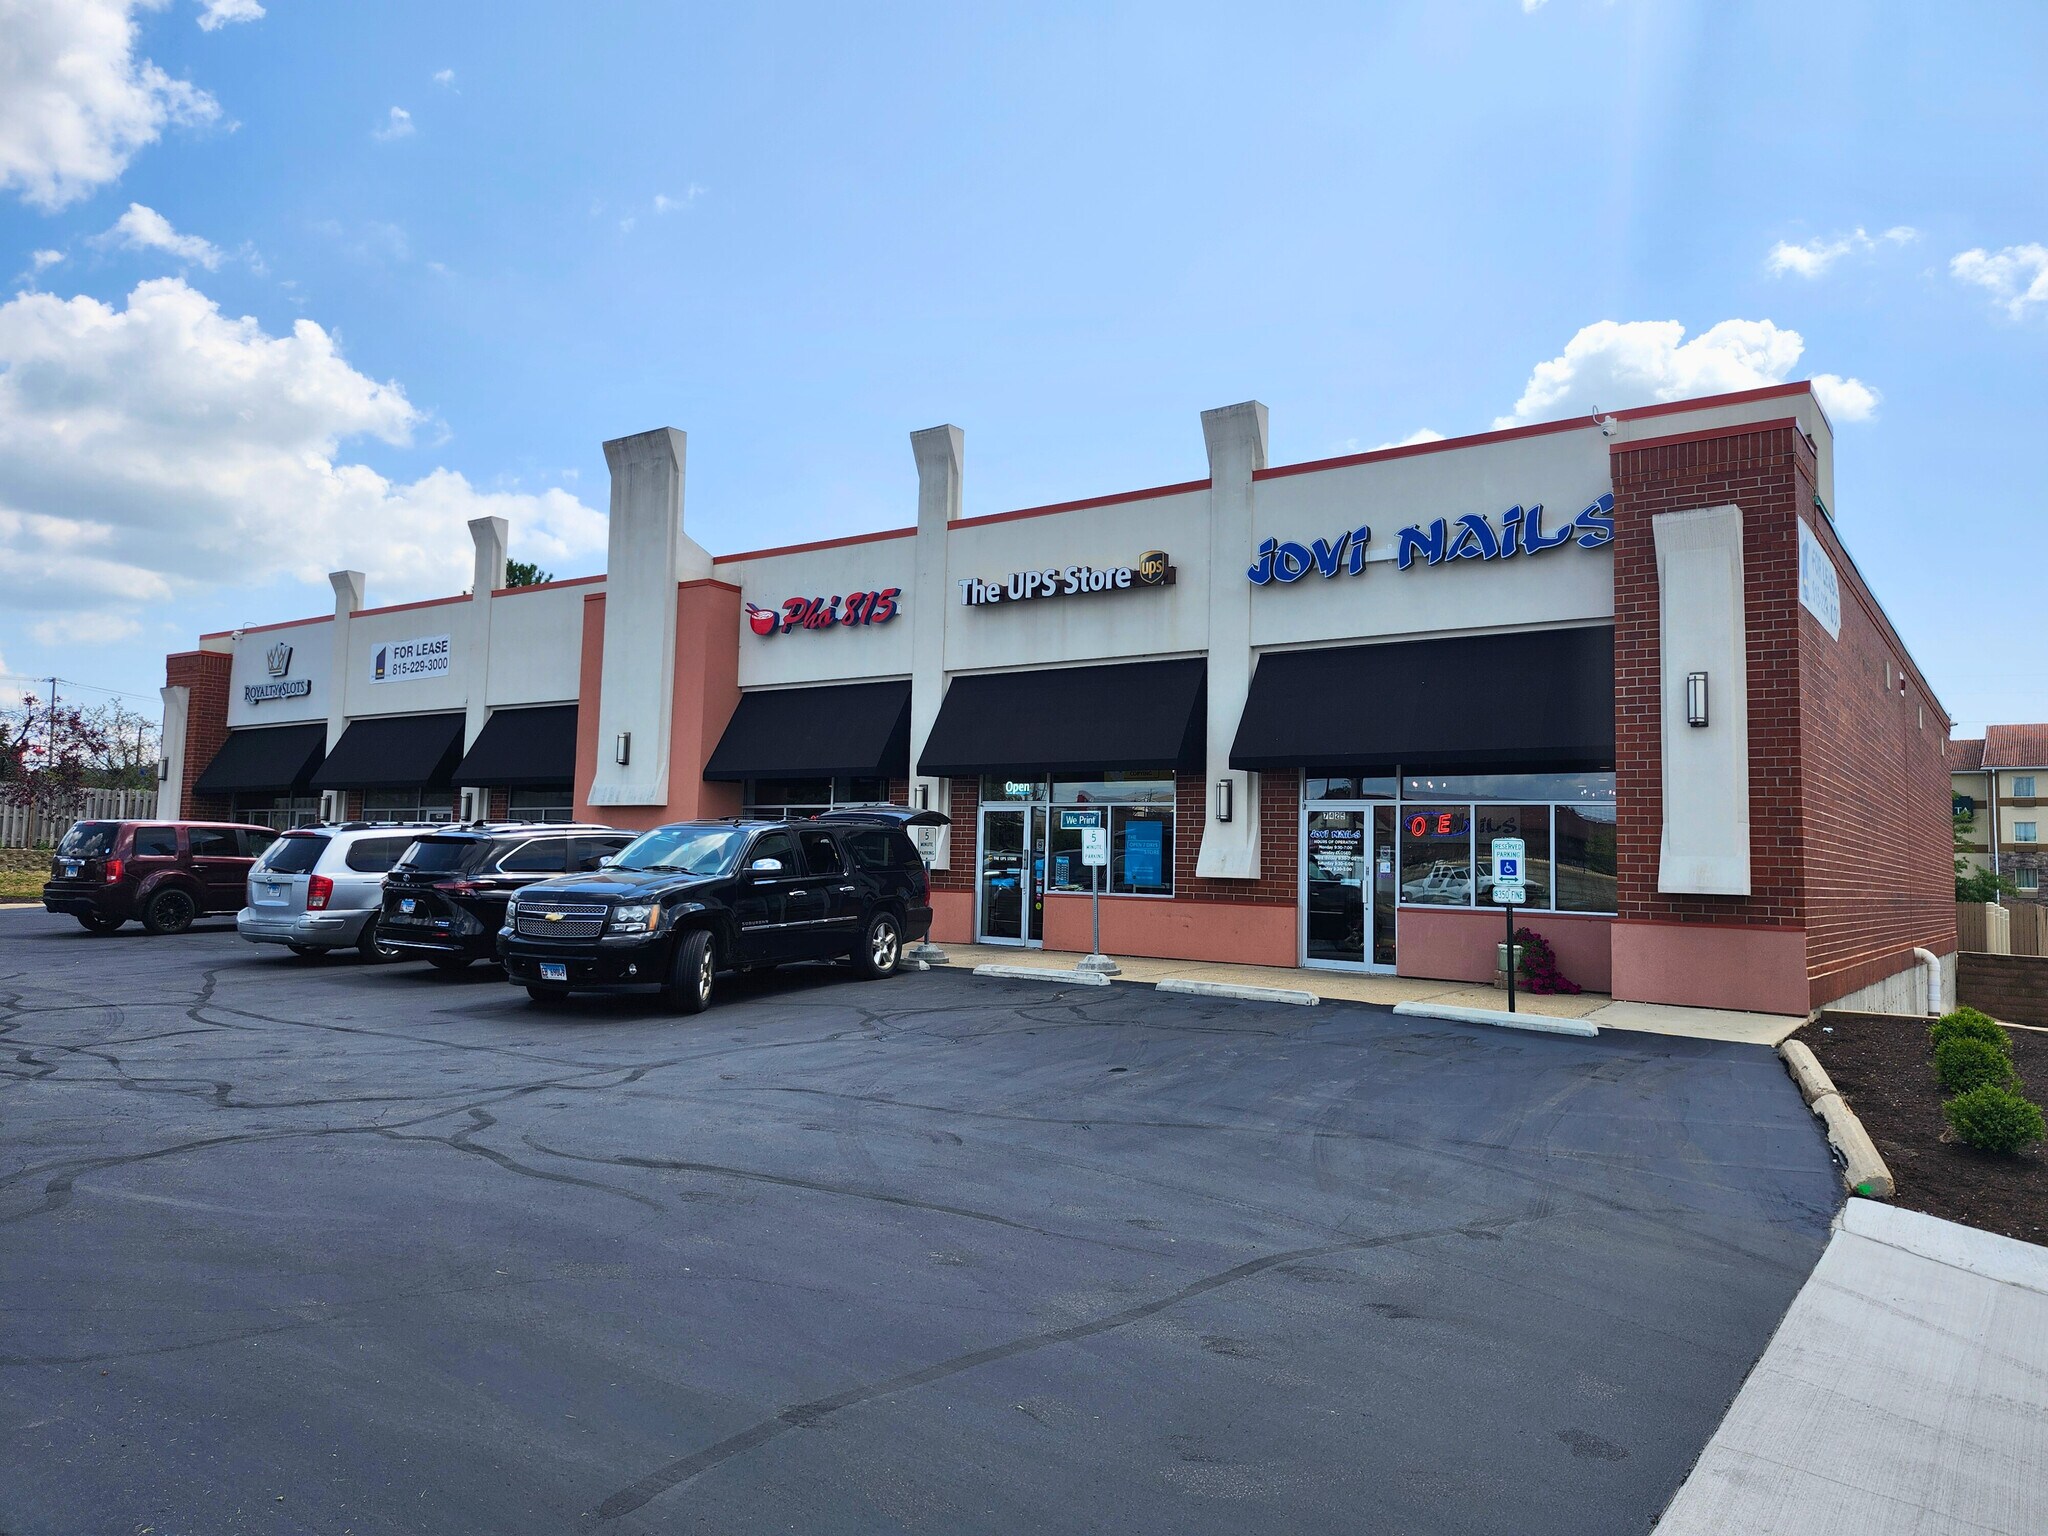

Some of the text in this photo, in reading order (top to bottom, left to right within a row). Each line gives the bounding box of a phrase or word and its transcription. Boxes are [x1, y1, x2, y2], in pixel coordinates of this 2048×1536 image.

[1141, 560, 1163, 578] ups
[958, 566, 1132, 605] The UPS Store
[841, 588, 901, 626] 815
[394, 640, 448, 659] FOR LEASE
[392, 657, 448, 675] 815-229-3000
[281, 681, 305, 696] SLOTS
[1005, 781, 1030, 795] Open
[1066, 815, 1096, 825] We Print
[925, 832, 930, 840] 5
[1091, 833, 1097, 843] 5
[1494, 843, 1523, 851] RESERVED
[1496, 851, 1521, 859] PARKING
[1494, 890, 1523, 900] $350 FINE
